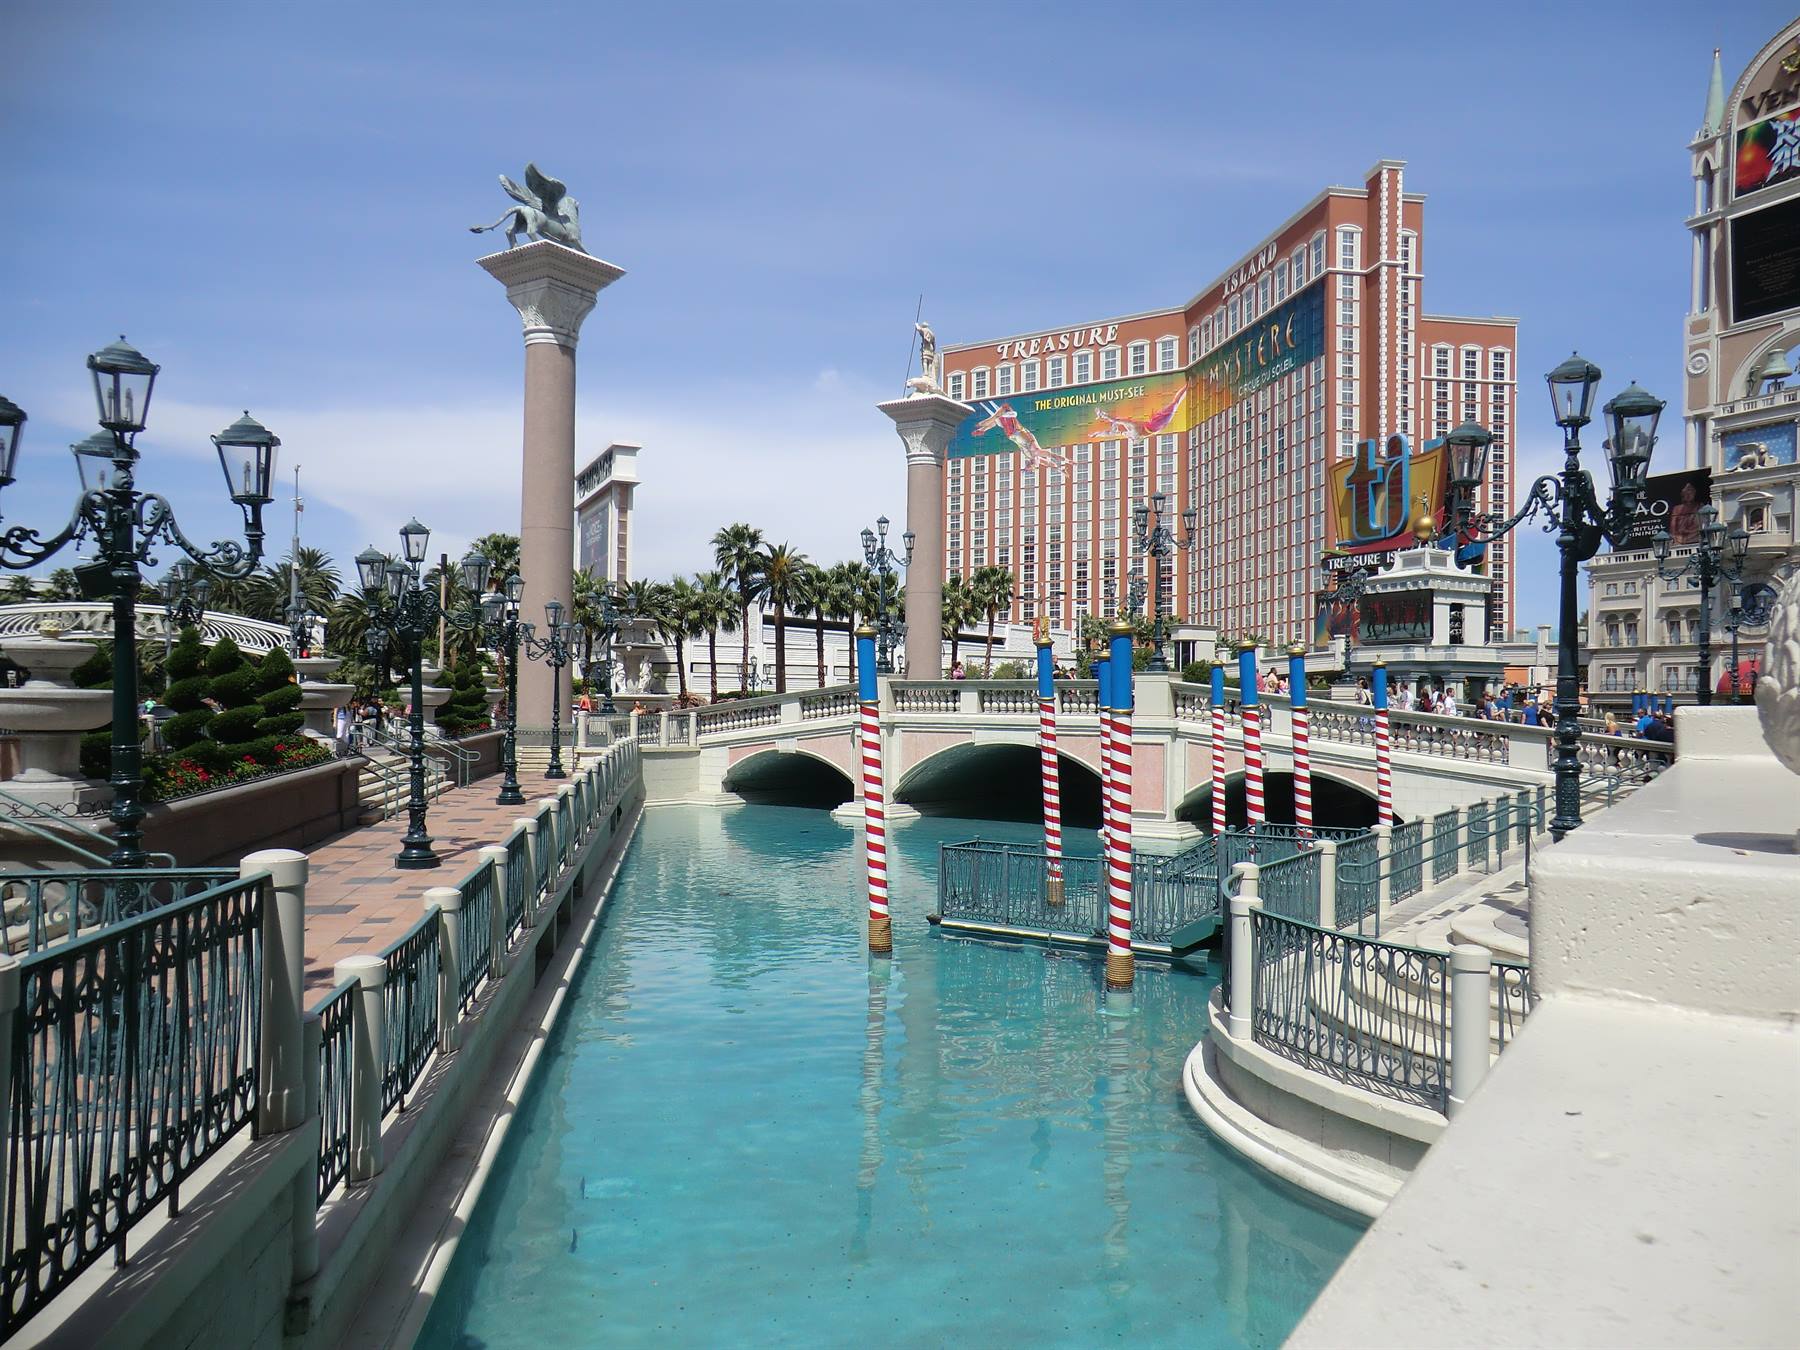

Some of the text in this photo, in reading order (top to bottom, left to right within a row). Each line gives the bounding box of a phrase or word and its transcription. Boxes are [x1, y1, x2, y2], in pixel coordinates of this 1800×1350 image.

[997, 241, 1277, 360] TREASURE ISLAND
[1035, 385, 1145, 411] THE ORIGINAL MUST-SEE
[1633, 500, 1669, 517] AO
[1327, 553, 1380, 570] TRESURE
